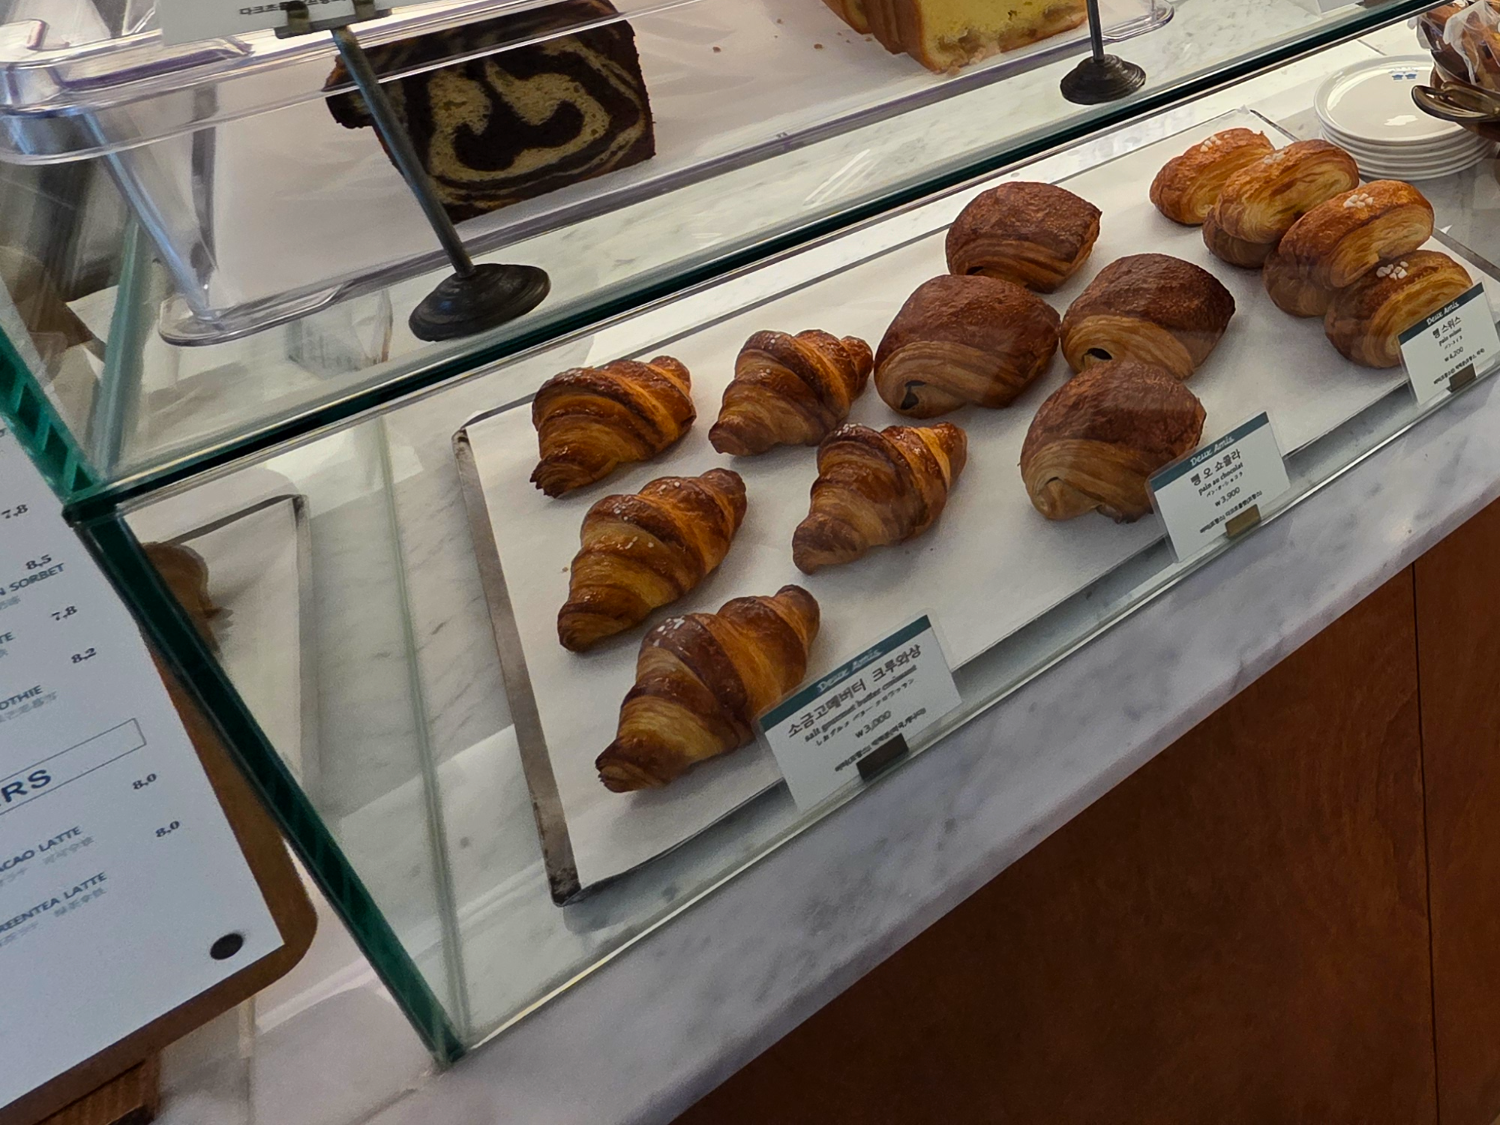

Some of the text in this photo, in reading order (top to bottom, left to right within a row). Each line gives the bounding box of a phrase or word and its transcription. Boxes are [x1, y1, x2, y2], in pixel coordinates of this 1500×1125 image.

[1425, 300, 1460, 326] Deux Amis
[1441, 316, 1462, 333] 스위스
[1190, 435, 1235, 467] Deux Amis
[1203, 466, 1213, 479] 오
[1214, 448, 1241, 473] 쇼콜라
[1198, 461, 1245, 497] pain au chocolat
[1220, 486, 1241, 505] 3,900
[1, 504, 28, 520] 7,8
[25, 554, 52, 570] 8,5
[9, 562, 64, 592] SORBET
[50, 605, 78, 621] 7,8
[71, 647, 97, 664] 8,2
[818, 647, 884, 693] Deux Amis
[787, 643, 921, 738] 소금고메버터 크루와상
[804, 728, 822, 743] salt
[856, 687, 882, 709] butter
[132, 773, 157, 790] 8,0
[38, 825, 83, 853] LATTE
[155, 820, 181, 838] 8,0
[63, 871, 108, 900] LATTE
